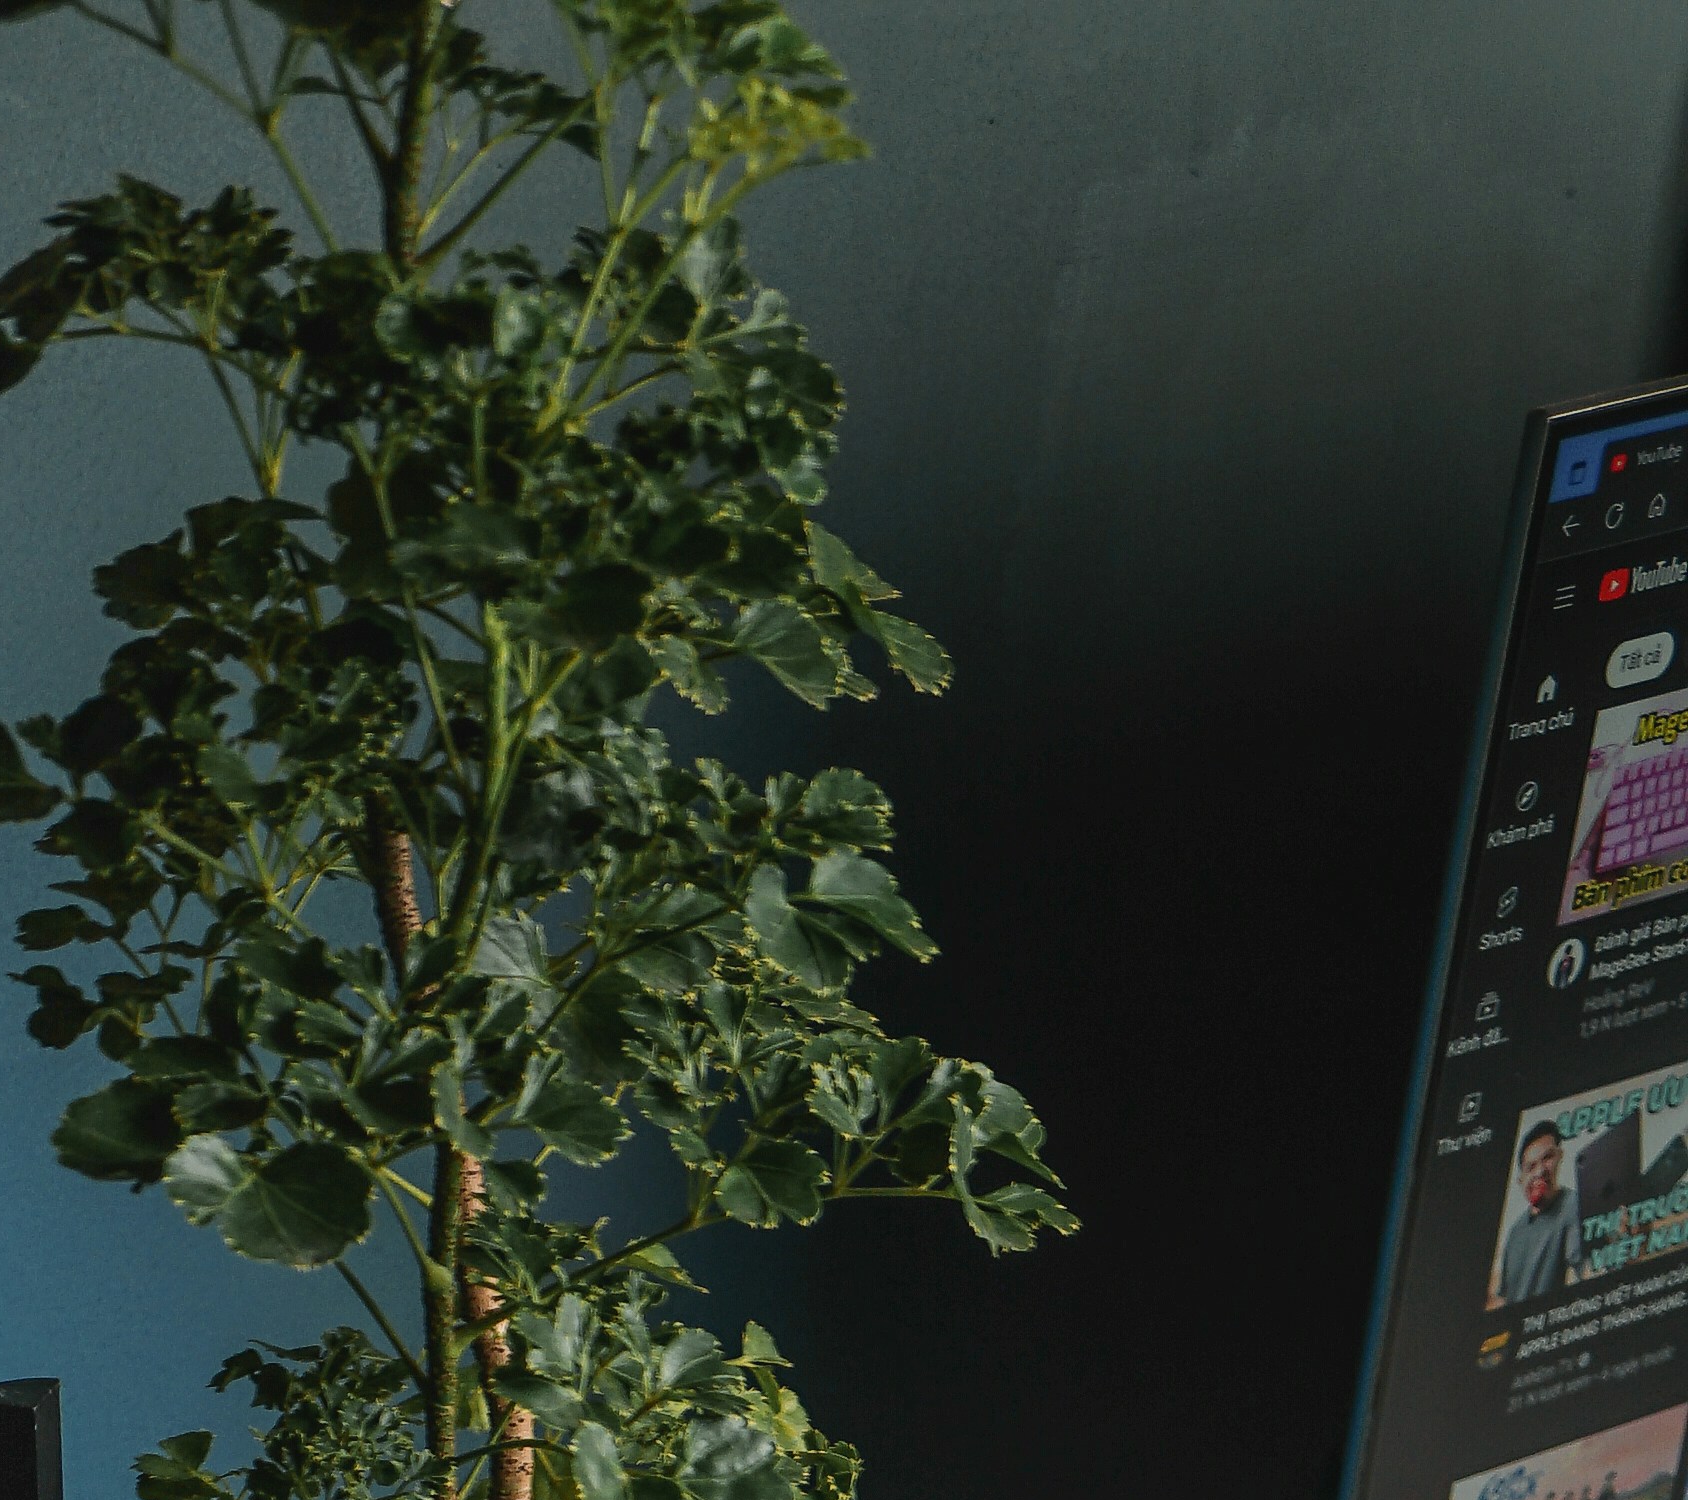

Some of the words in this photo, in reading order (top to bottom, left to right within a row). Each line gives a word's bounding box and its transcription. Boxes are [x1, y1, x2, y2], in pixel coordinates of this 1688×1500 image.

[1637, 444, 1683, 465] YouTube
[1630, 556, 1688, 593] YouTube
[1479, 926, 1524, 951] Shorts
